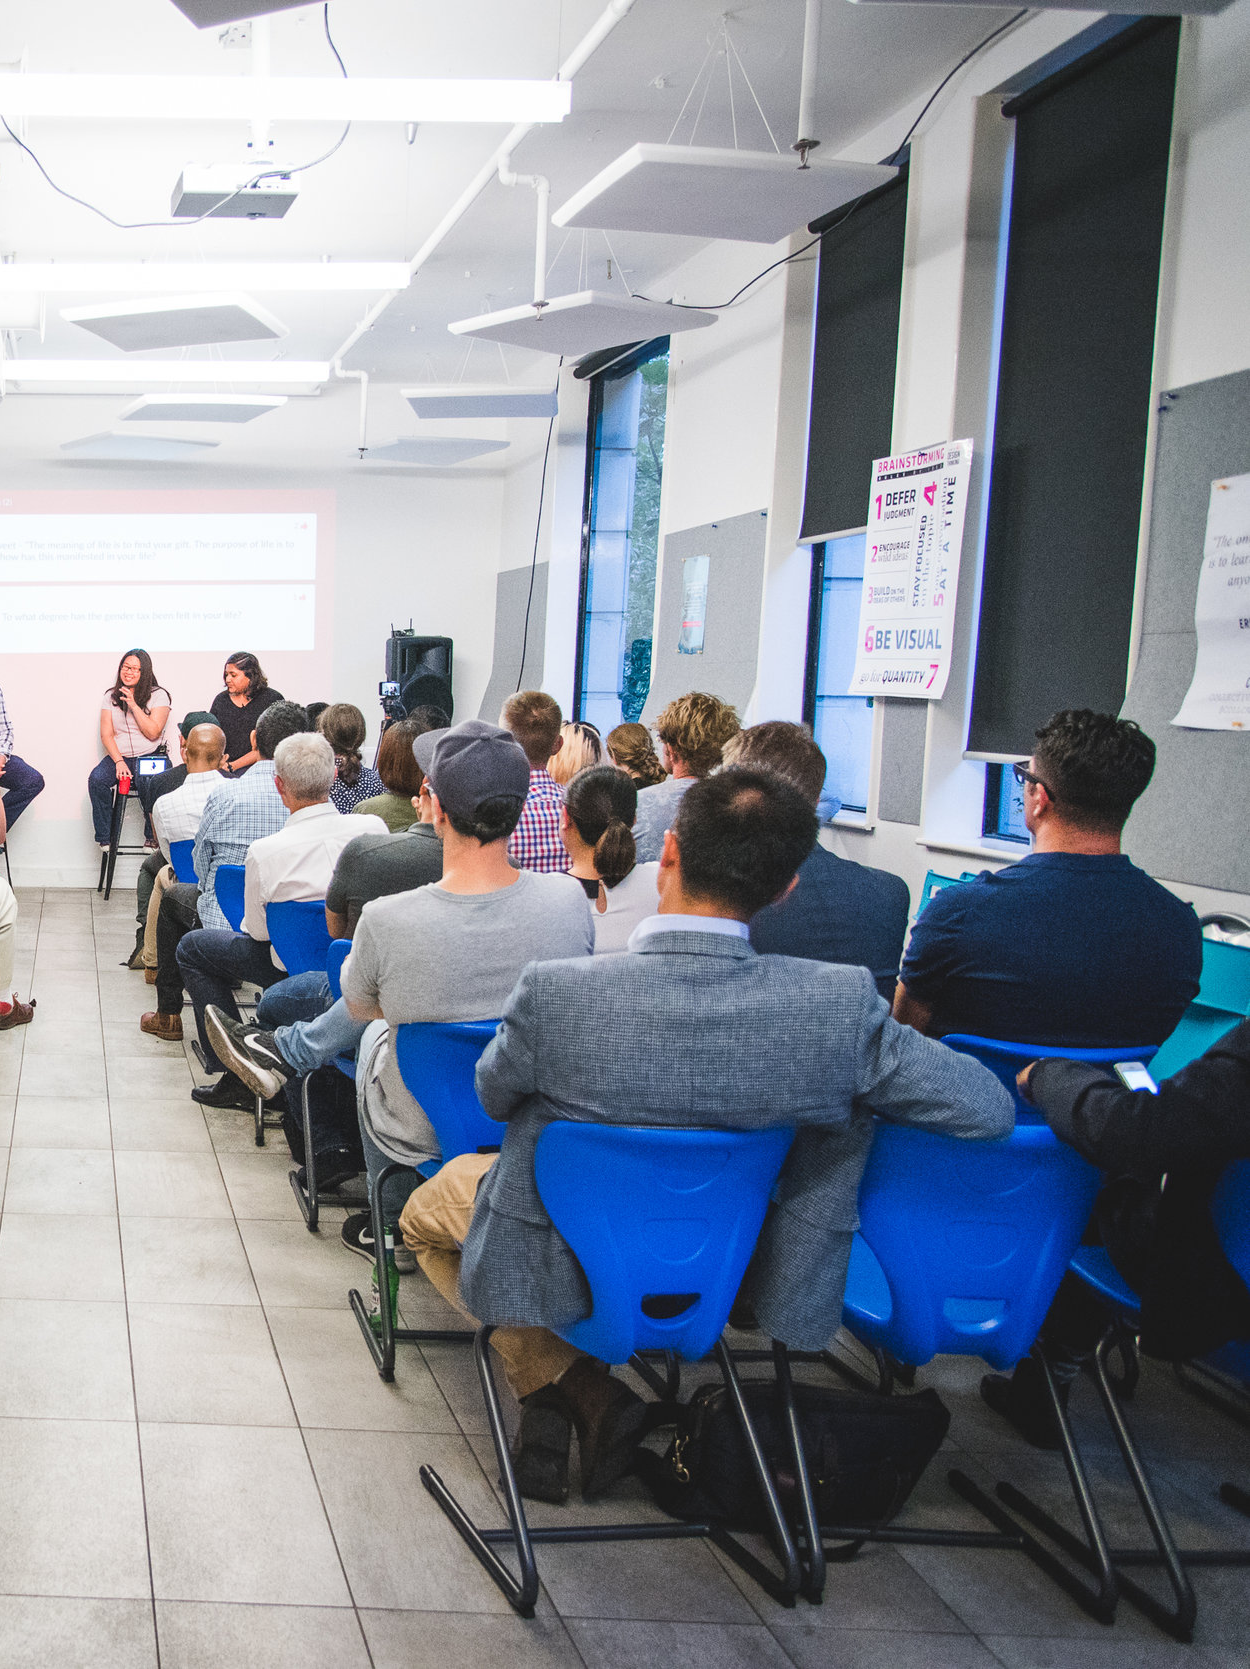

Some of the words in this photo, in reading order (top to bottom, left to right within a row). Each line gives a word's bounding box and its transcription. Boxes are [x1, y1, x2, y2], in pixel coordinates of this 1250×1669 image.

[878, 447, 945, 473] BRAINSTORMING
[875, 494, 883, 520] 1
[885, 489, 917, 507] DEFER
[944, 476, 957, 528] TIME
[47, 541, 84, 552] meaning
[98, 541, 112, 550] life
[123, 541, 133, 550] to
[153, 543, 172, 552] your
[194, 541, 210, 550] The
[212, 543, 247, 552] purpose
[261, 541, 274, 550] life
[286, 541, 295, 550] to
[915, 515, 928, 573] FOCUSED
[1235, 535, 1250, 546] on
[21, 552, 36, 561] has
[38, 552, 54, 561] this
[871, 545, 878, 563] 2
[1231, 552, 1250, 567] lear
[912, 576, 921, 607] STAY
[15, 612, 36, 621] what
[38, 612, 70, 623] degree
[71, 612, 86, 621] has
[88, 612, 103, 621] the
[1239, 618, 1250, 629] ER
[865, 625, 875, 653] 6
[875, 629, 892, 650] BE
[895, 628, 942, 650] VISUAL
[882, 670, 926, 685] QUANTITY
[926, 664, 939, 689] 7
